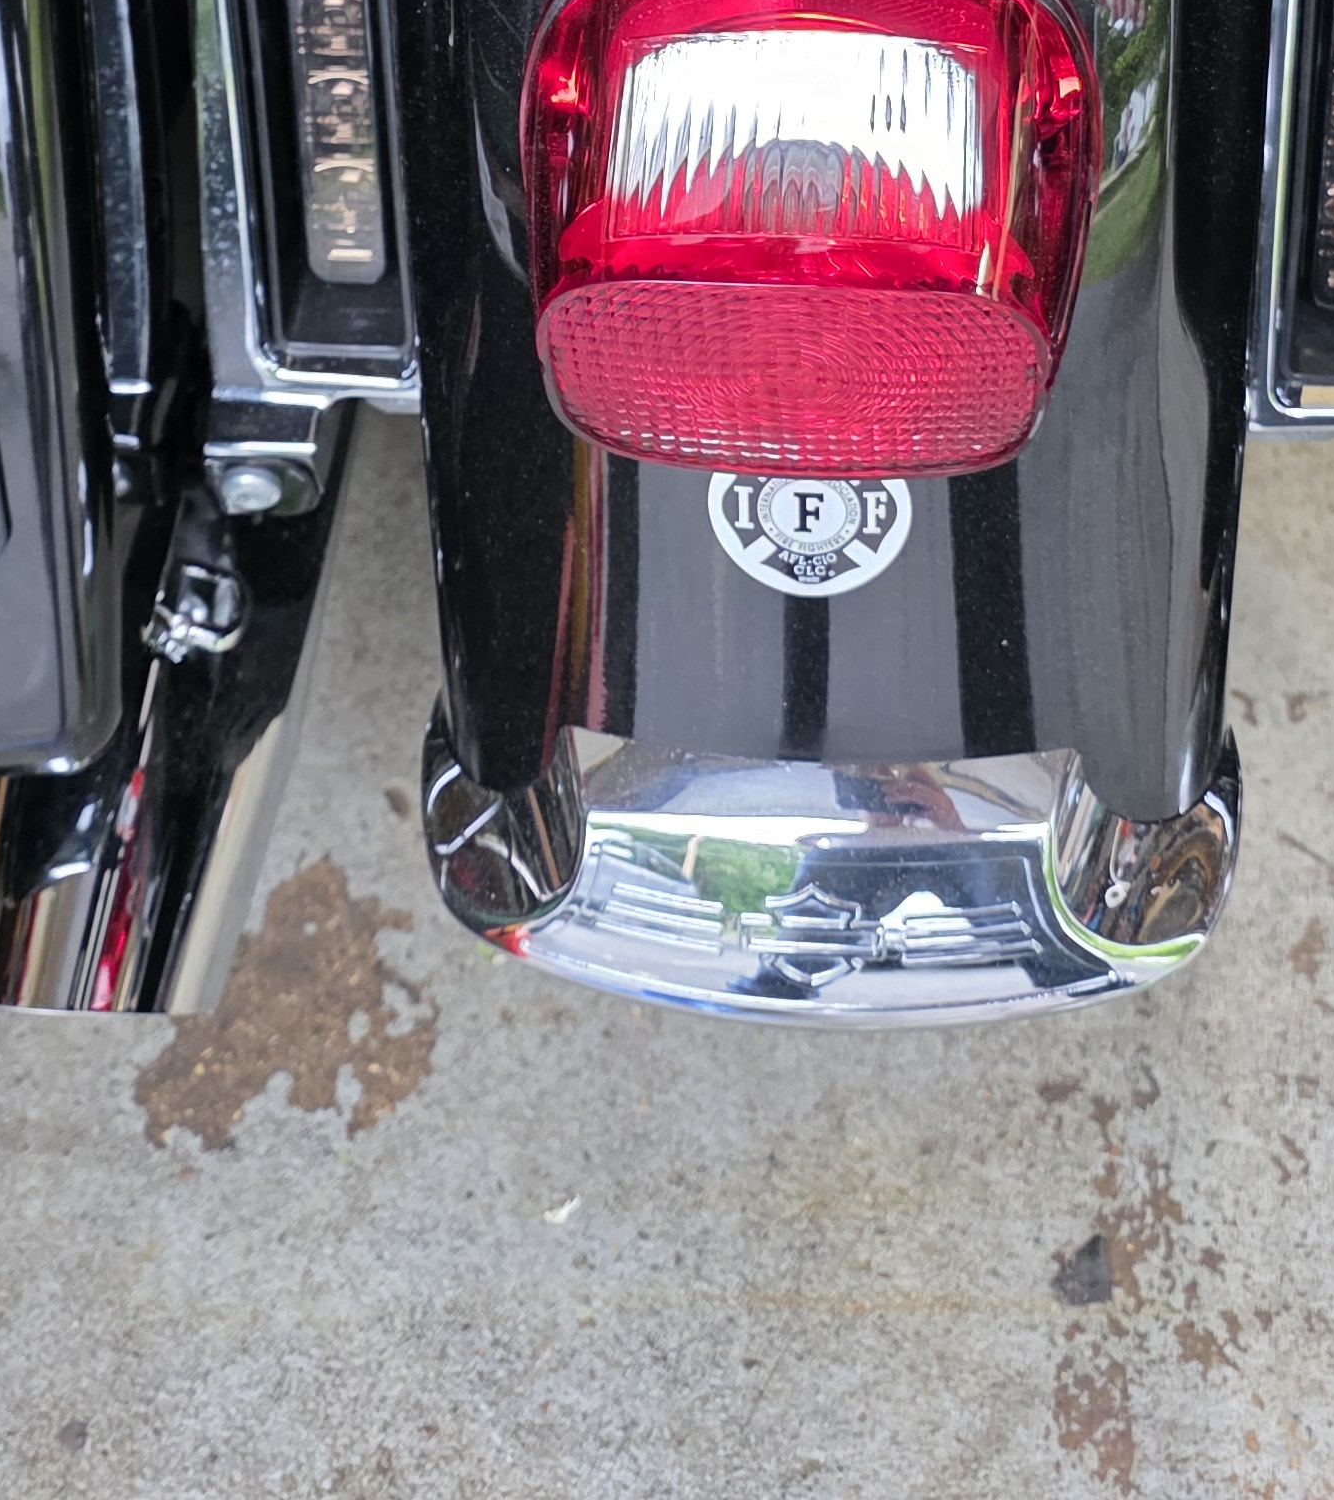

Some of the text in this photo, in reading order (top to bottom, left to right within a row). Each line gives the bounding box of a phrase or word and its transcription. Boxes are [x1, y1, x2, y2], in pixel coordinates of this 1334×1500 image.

[793, 491, 824, 533] F
[862, 491, 887, 534] F
[798, 534, 846, 552] FIGHTERS
[778, 550, 837, 566] AFL-CIO
